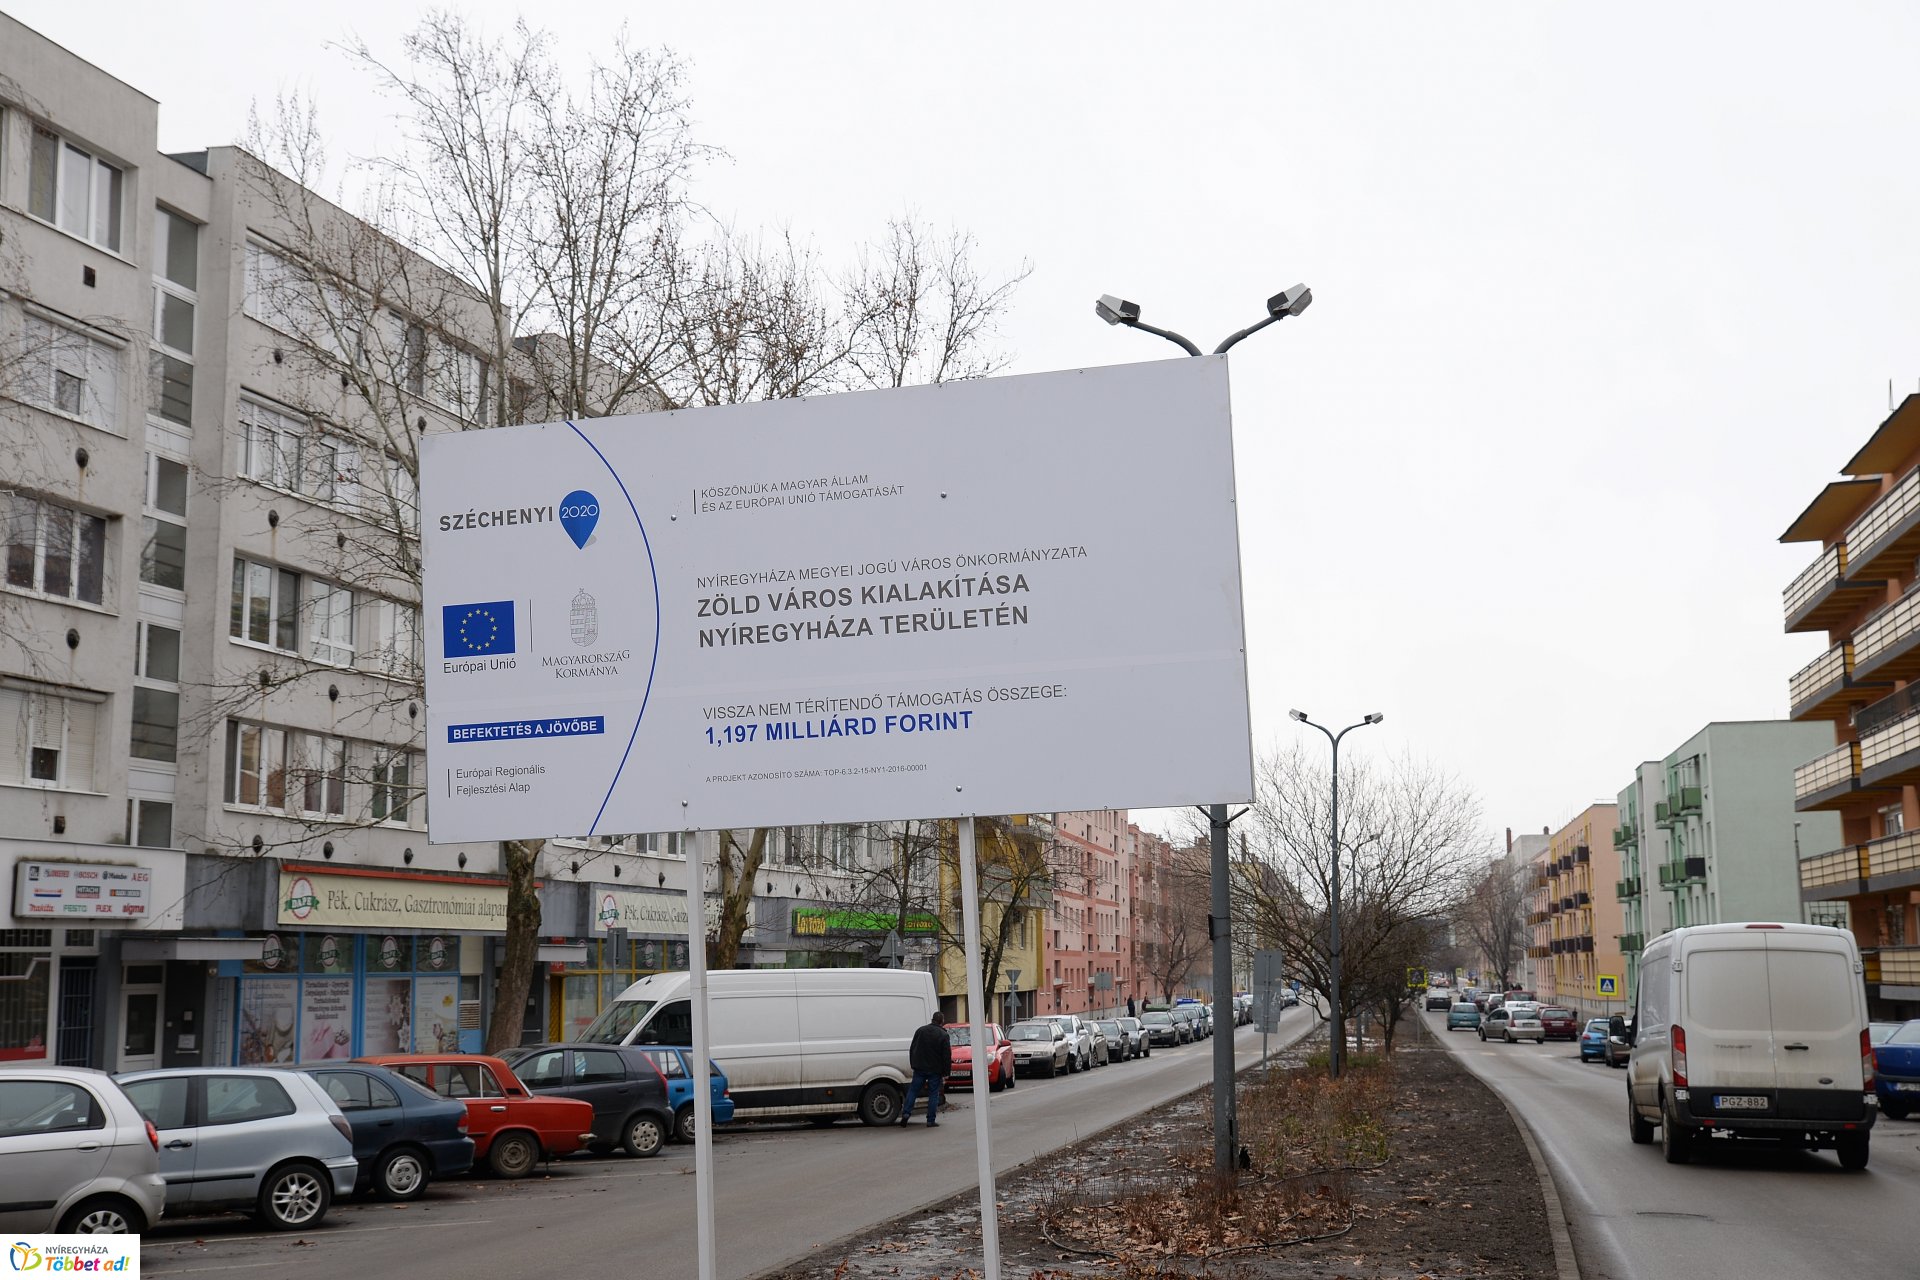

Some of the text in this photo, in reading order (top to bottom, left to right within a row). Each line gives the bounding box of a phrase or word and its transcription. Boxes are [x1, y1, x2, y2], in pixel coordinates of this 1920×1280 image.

[701, 474, 868, 499] KÖSZÖNJÜK A MAGYAR ÁLLAM
[701, 484, 905, 513] ÉS AZ EURÓPAI UNIÓ TÁMOGATÁSÁT
[439, 501, 600, 532] SZÉCHENYI 2020
[697, 545, 1088, 589] NYÍREGYHÁZA MEGYEI JOGÚ VÁROS ÖNKORMÁNYZATA
[697, 573, 1030, 618] ZÖLD VÁROS KIALAKÍTÁSA
[699, 604, 1028, 648] NYÍREGYHÁZA TERÜLETÉN
[443, 657, 517, 675] Európai Unió
[541, 649, 630, 667] MAGYARORSZÁG
[555, 665, 619, 679] KORMÁNYA
[702, 684, 1067, 720] VISSZA NEM TÉRÍTENDŐ TÁMOGATÁS ÖSSZEGE:
[453, 718, 598, 740] BEFEKTETÉS A JÖVŐBE
[705, 710, 973, 748] 1,197 MILLIÁRD FORINT
[456, 764, 546, 780] Európai Regionális
[705, 775, 712, 784] A
[712, 773, 747, 784] PROJEKT
[747, 770, 793, 782] AZONOSÍTÓ
[794, 769, 823, 779] SZÁMA:
[456, 782, 531, 798] Fejlesztési Alap
[131, 872, 149, 882] AEG
[354, 891, 402, 917] Cukrász,
[404, 893, 476, 917] Gasztronómiai
[1721, 1097, 1766, 1107] PGZ-882
